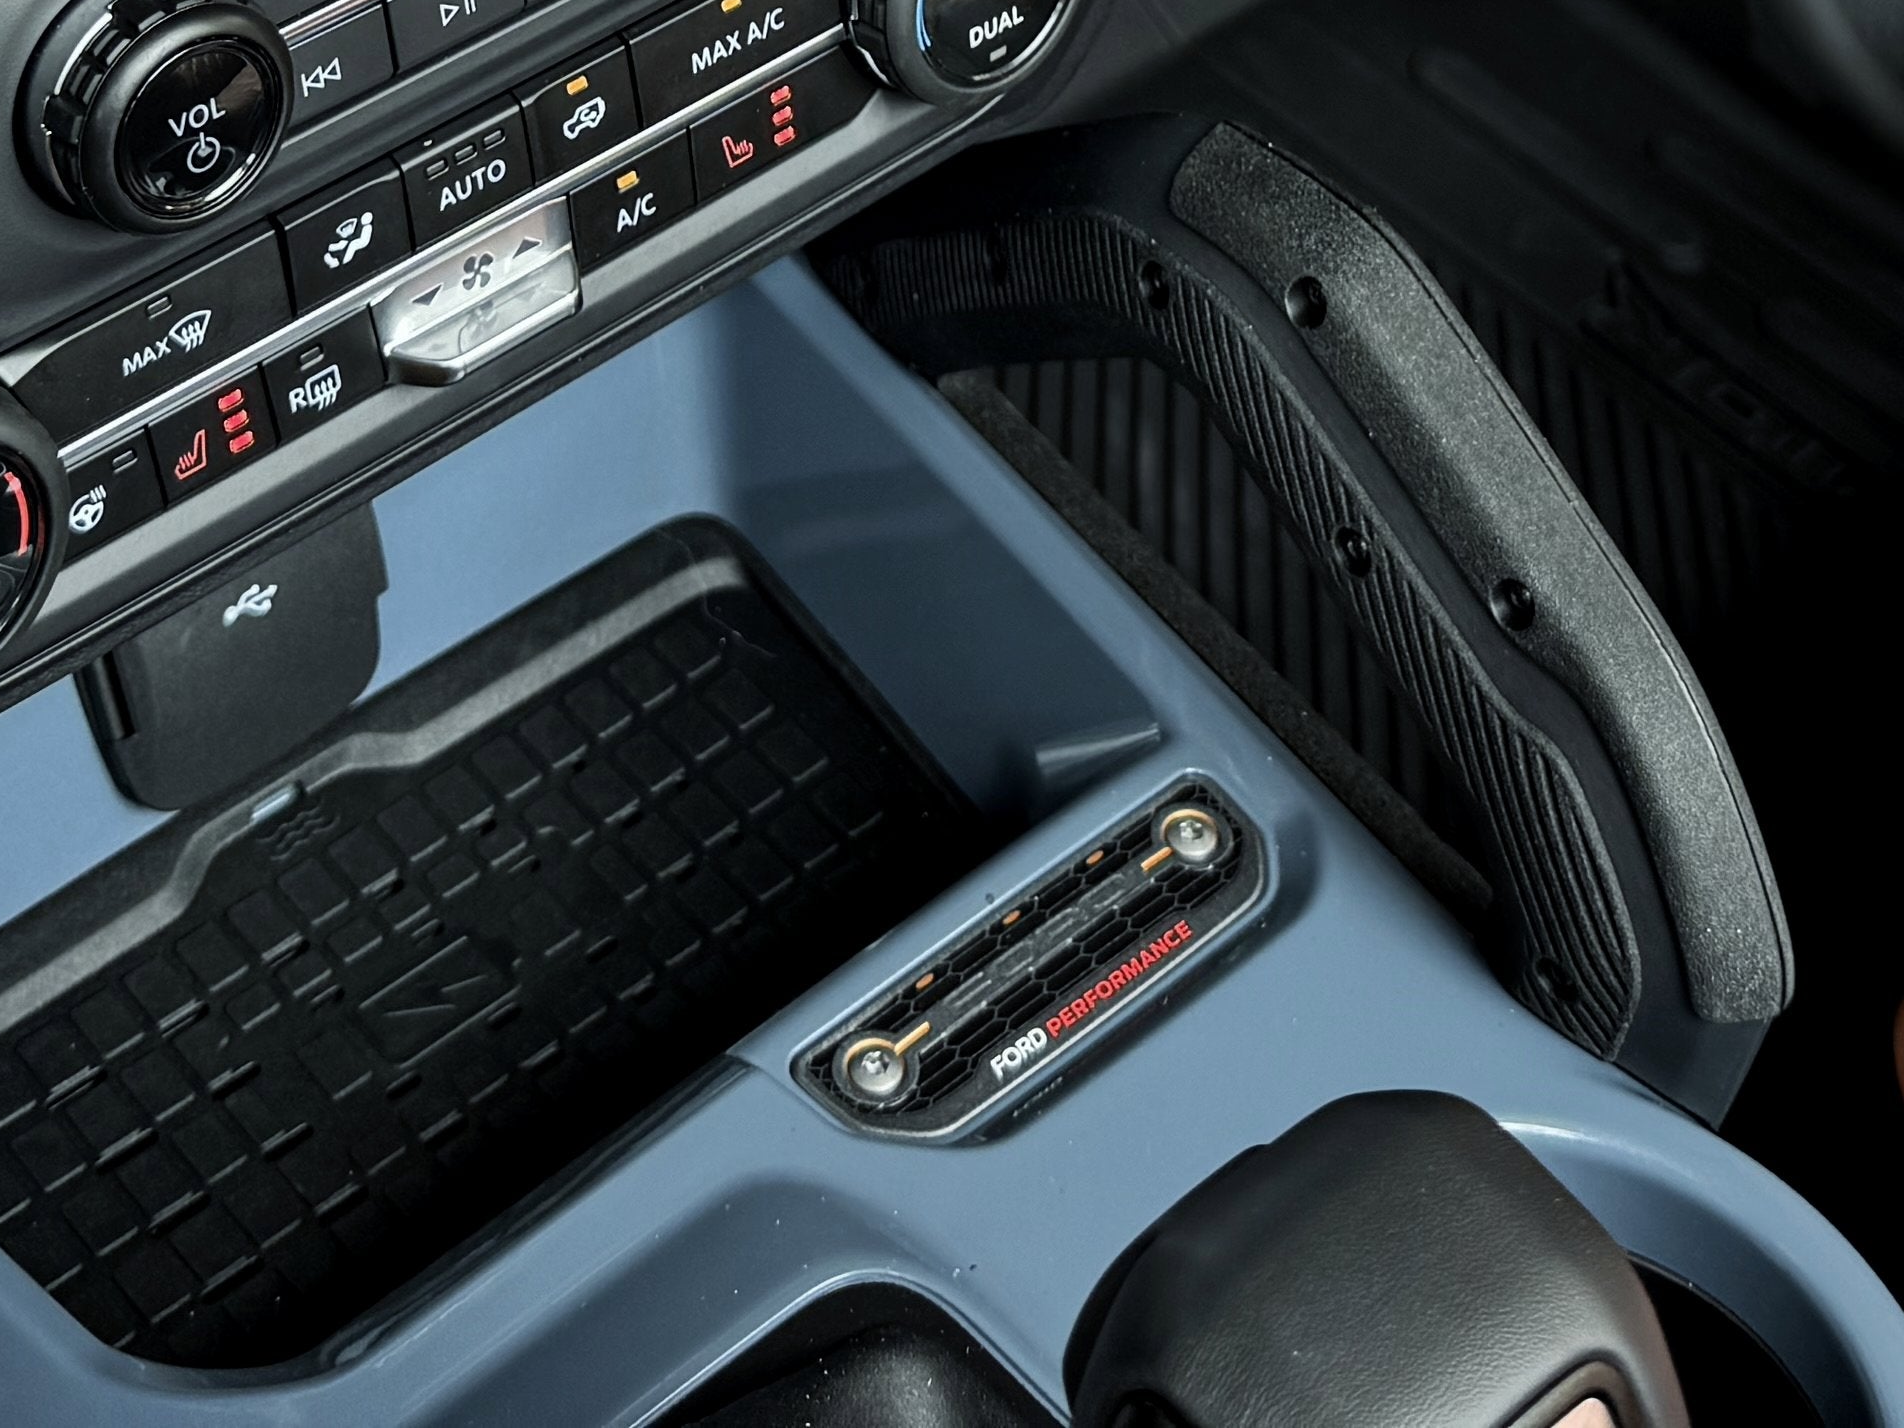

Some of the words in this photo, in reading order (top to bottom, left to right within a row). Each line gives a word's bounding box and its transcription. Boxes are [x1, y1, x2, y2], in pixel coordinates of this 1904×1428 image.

[691, 30, 742, 74] MAX
[746, 5, 786, 47] A/C
[968, 4, 1026, 50] DUAL
[167, 99, 227, 138] VOL
[437, 158, 507, 212] AUTO
[615, 192, 658, 233] A/C
[122, 337, 173, 377] MAX
[288, 386, 308, 414] R
[989, 1026, 1048, 1082] FORD
[1045, 919, 1194, 1039] PERFORMANCE
